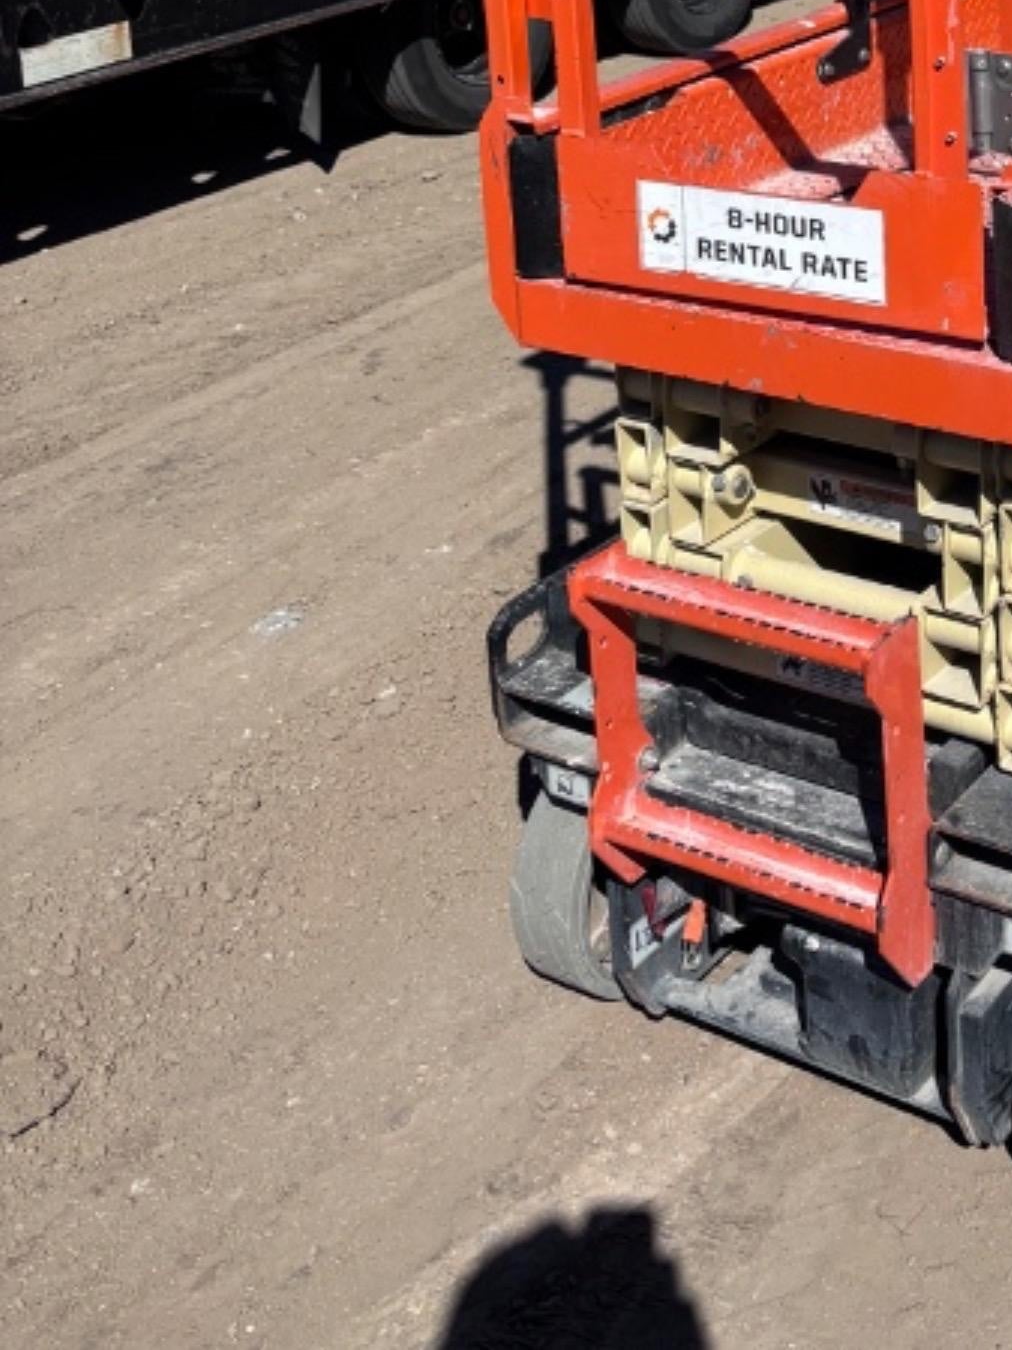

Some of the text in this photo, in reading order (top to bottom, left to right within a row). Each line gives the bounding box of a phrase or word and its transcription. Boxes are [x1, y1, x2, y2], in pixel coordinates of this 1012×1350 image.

[726, 207, 826, 242] 8-HOUR
[697, 236, 869, 283] RENTAL RATE
